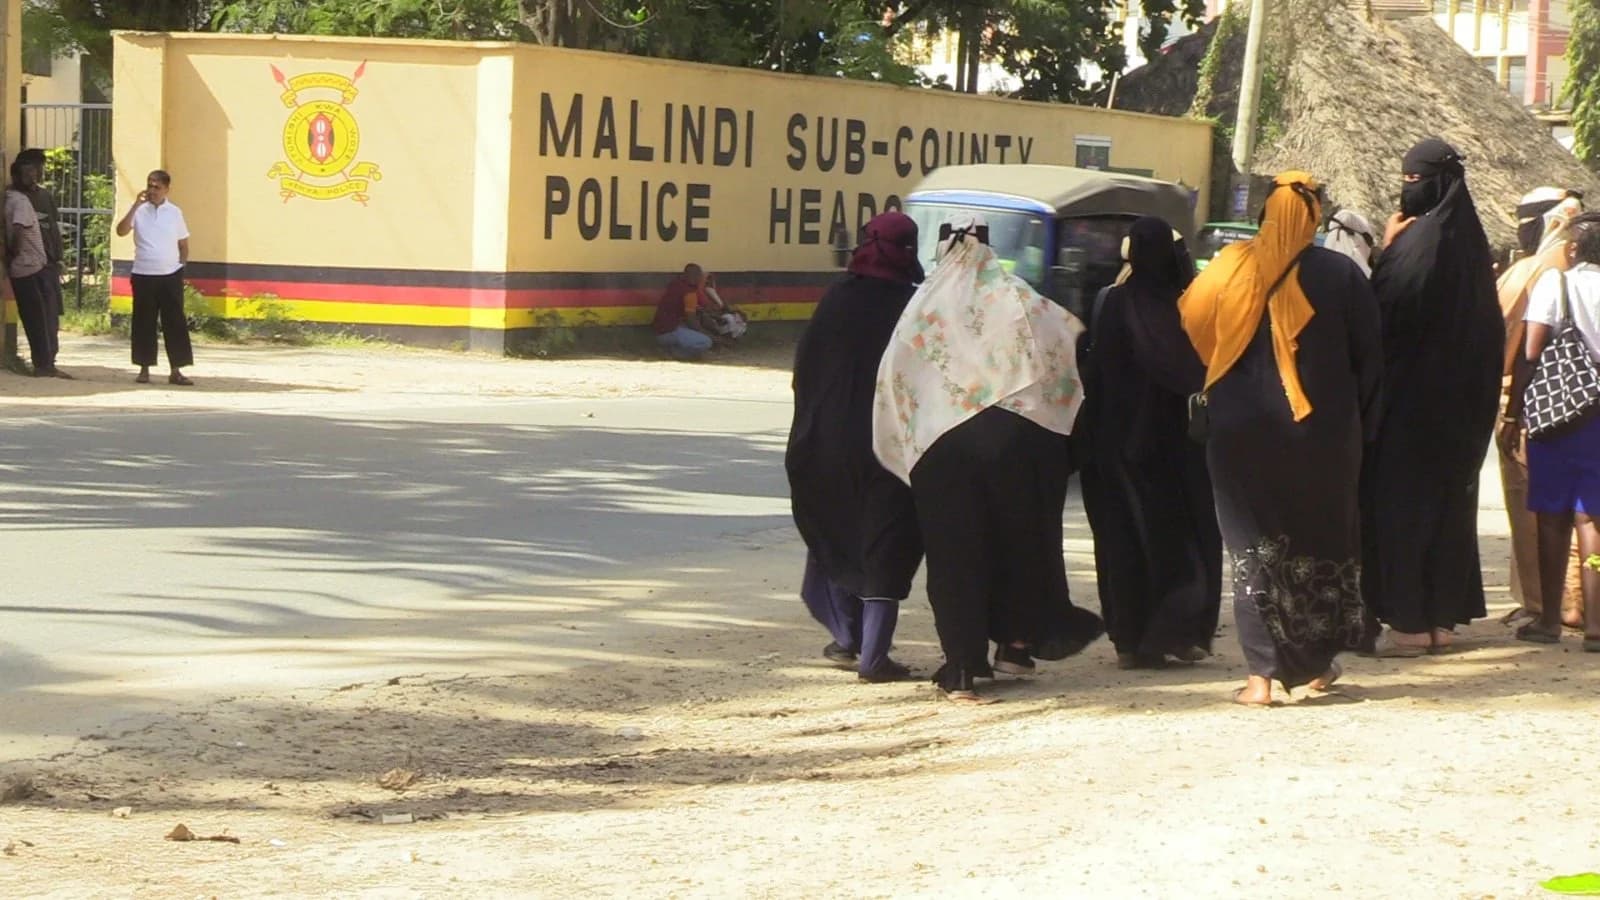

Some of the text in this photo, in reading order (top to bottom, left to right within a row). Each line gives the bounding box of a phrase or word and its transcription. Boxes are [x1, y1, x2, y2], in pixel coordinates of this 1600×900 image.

[539, 92, 1034, 178] MALINDI SUB-COUNTY
[327, 182, 363, 194] POLICE
[544, 175, 711, 242] POLICE
